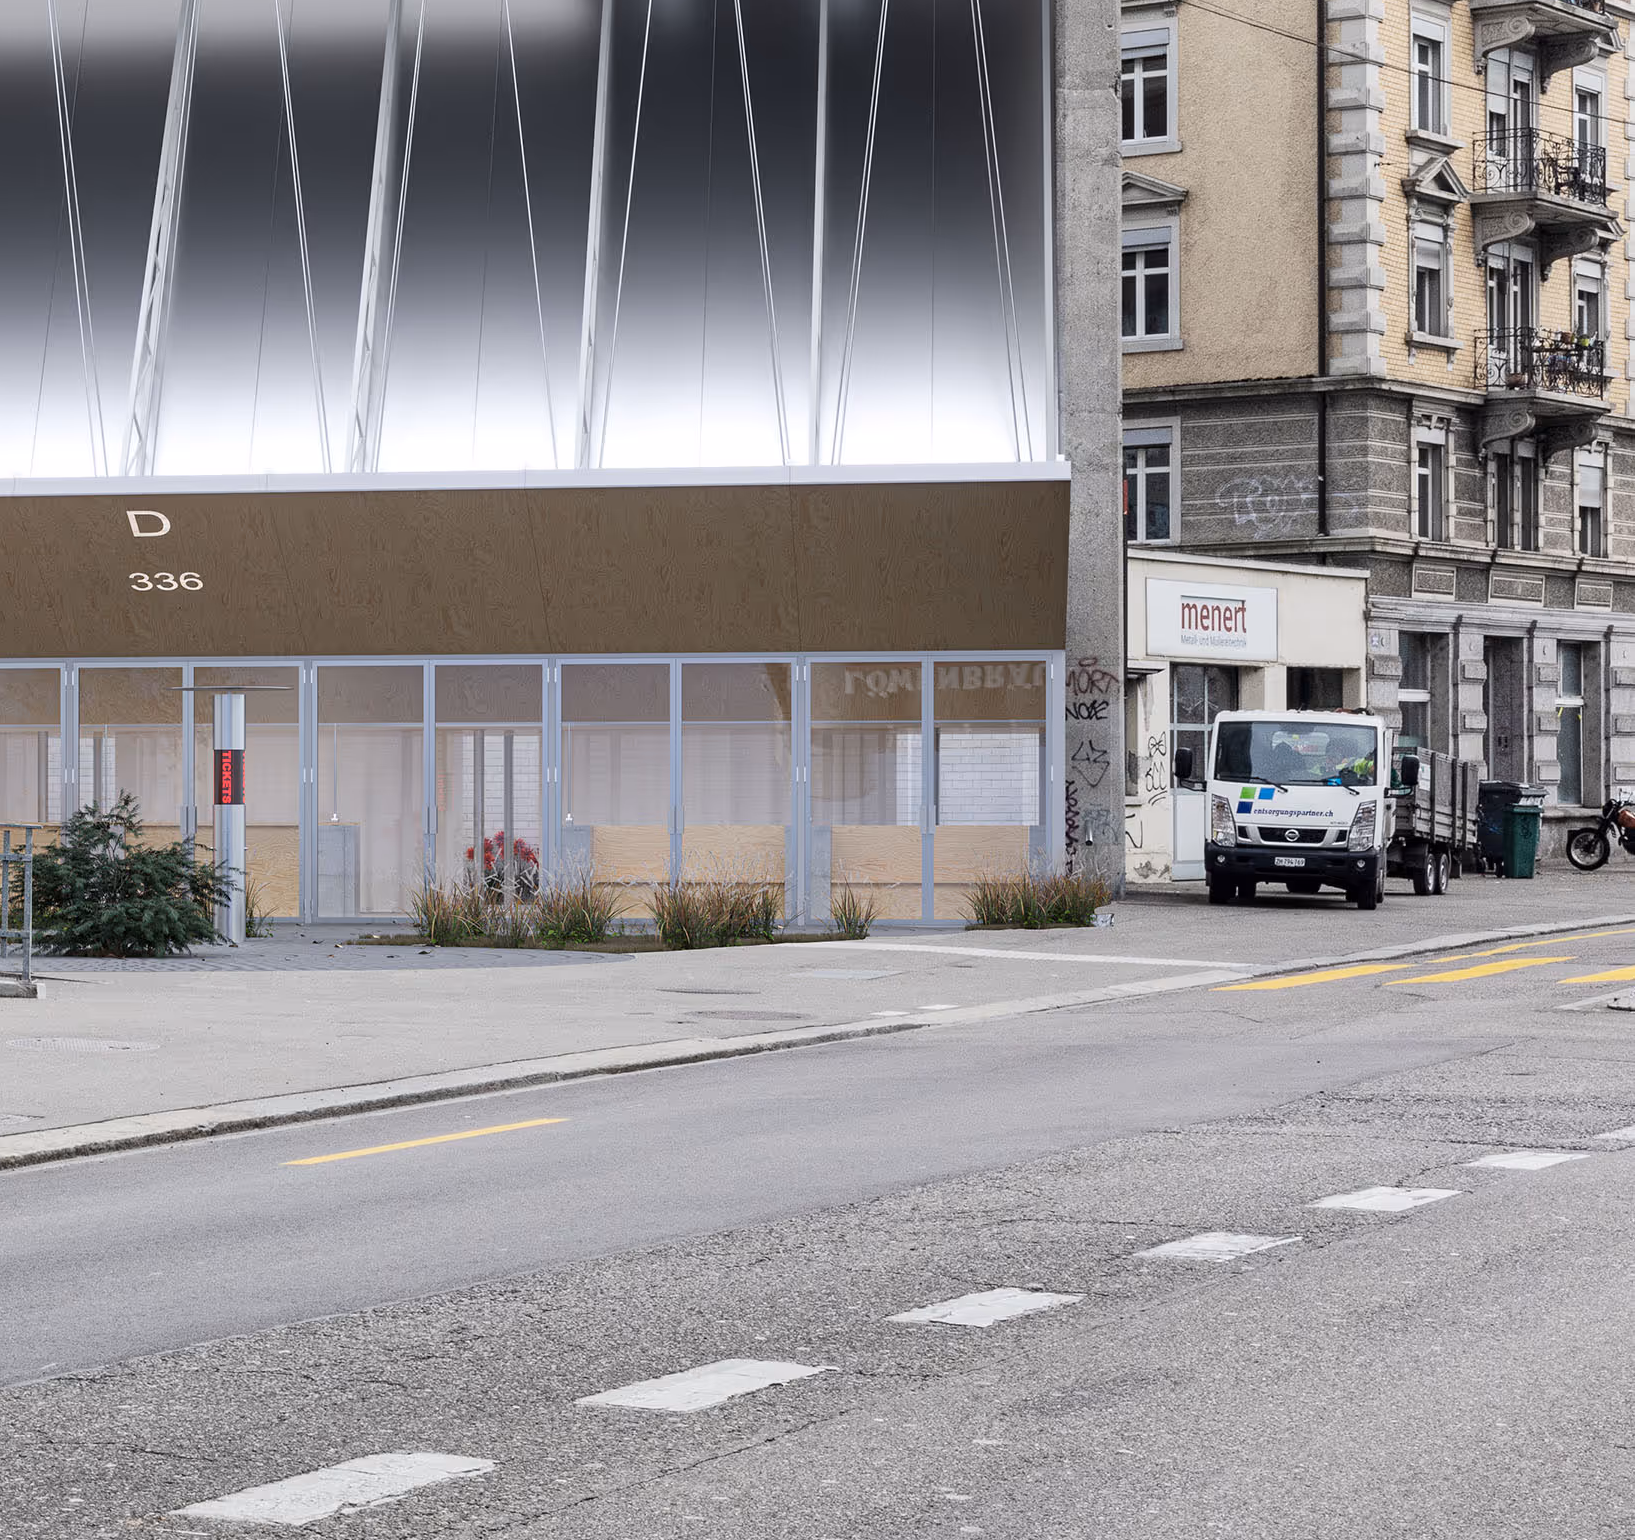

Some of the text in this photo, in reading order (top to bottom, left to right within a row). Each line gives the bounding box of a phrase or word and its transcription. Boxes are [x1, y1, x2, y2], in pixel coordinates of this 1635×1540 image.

[126, 510, 171, 538] D
[129, 571, 204, 591] 336
[1181, 599, 1247, 634] menert
[221, 750, 232, 804] TICKETS
[1253, 807, 1334, 818] entsorgungspartner.ch
